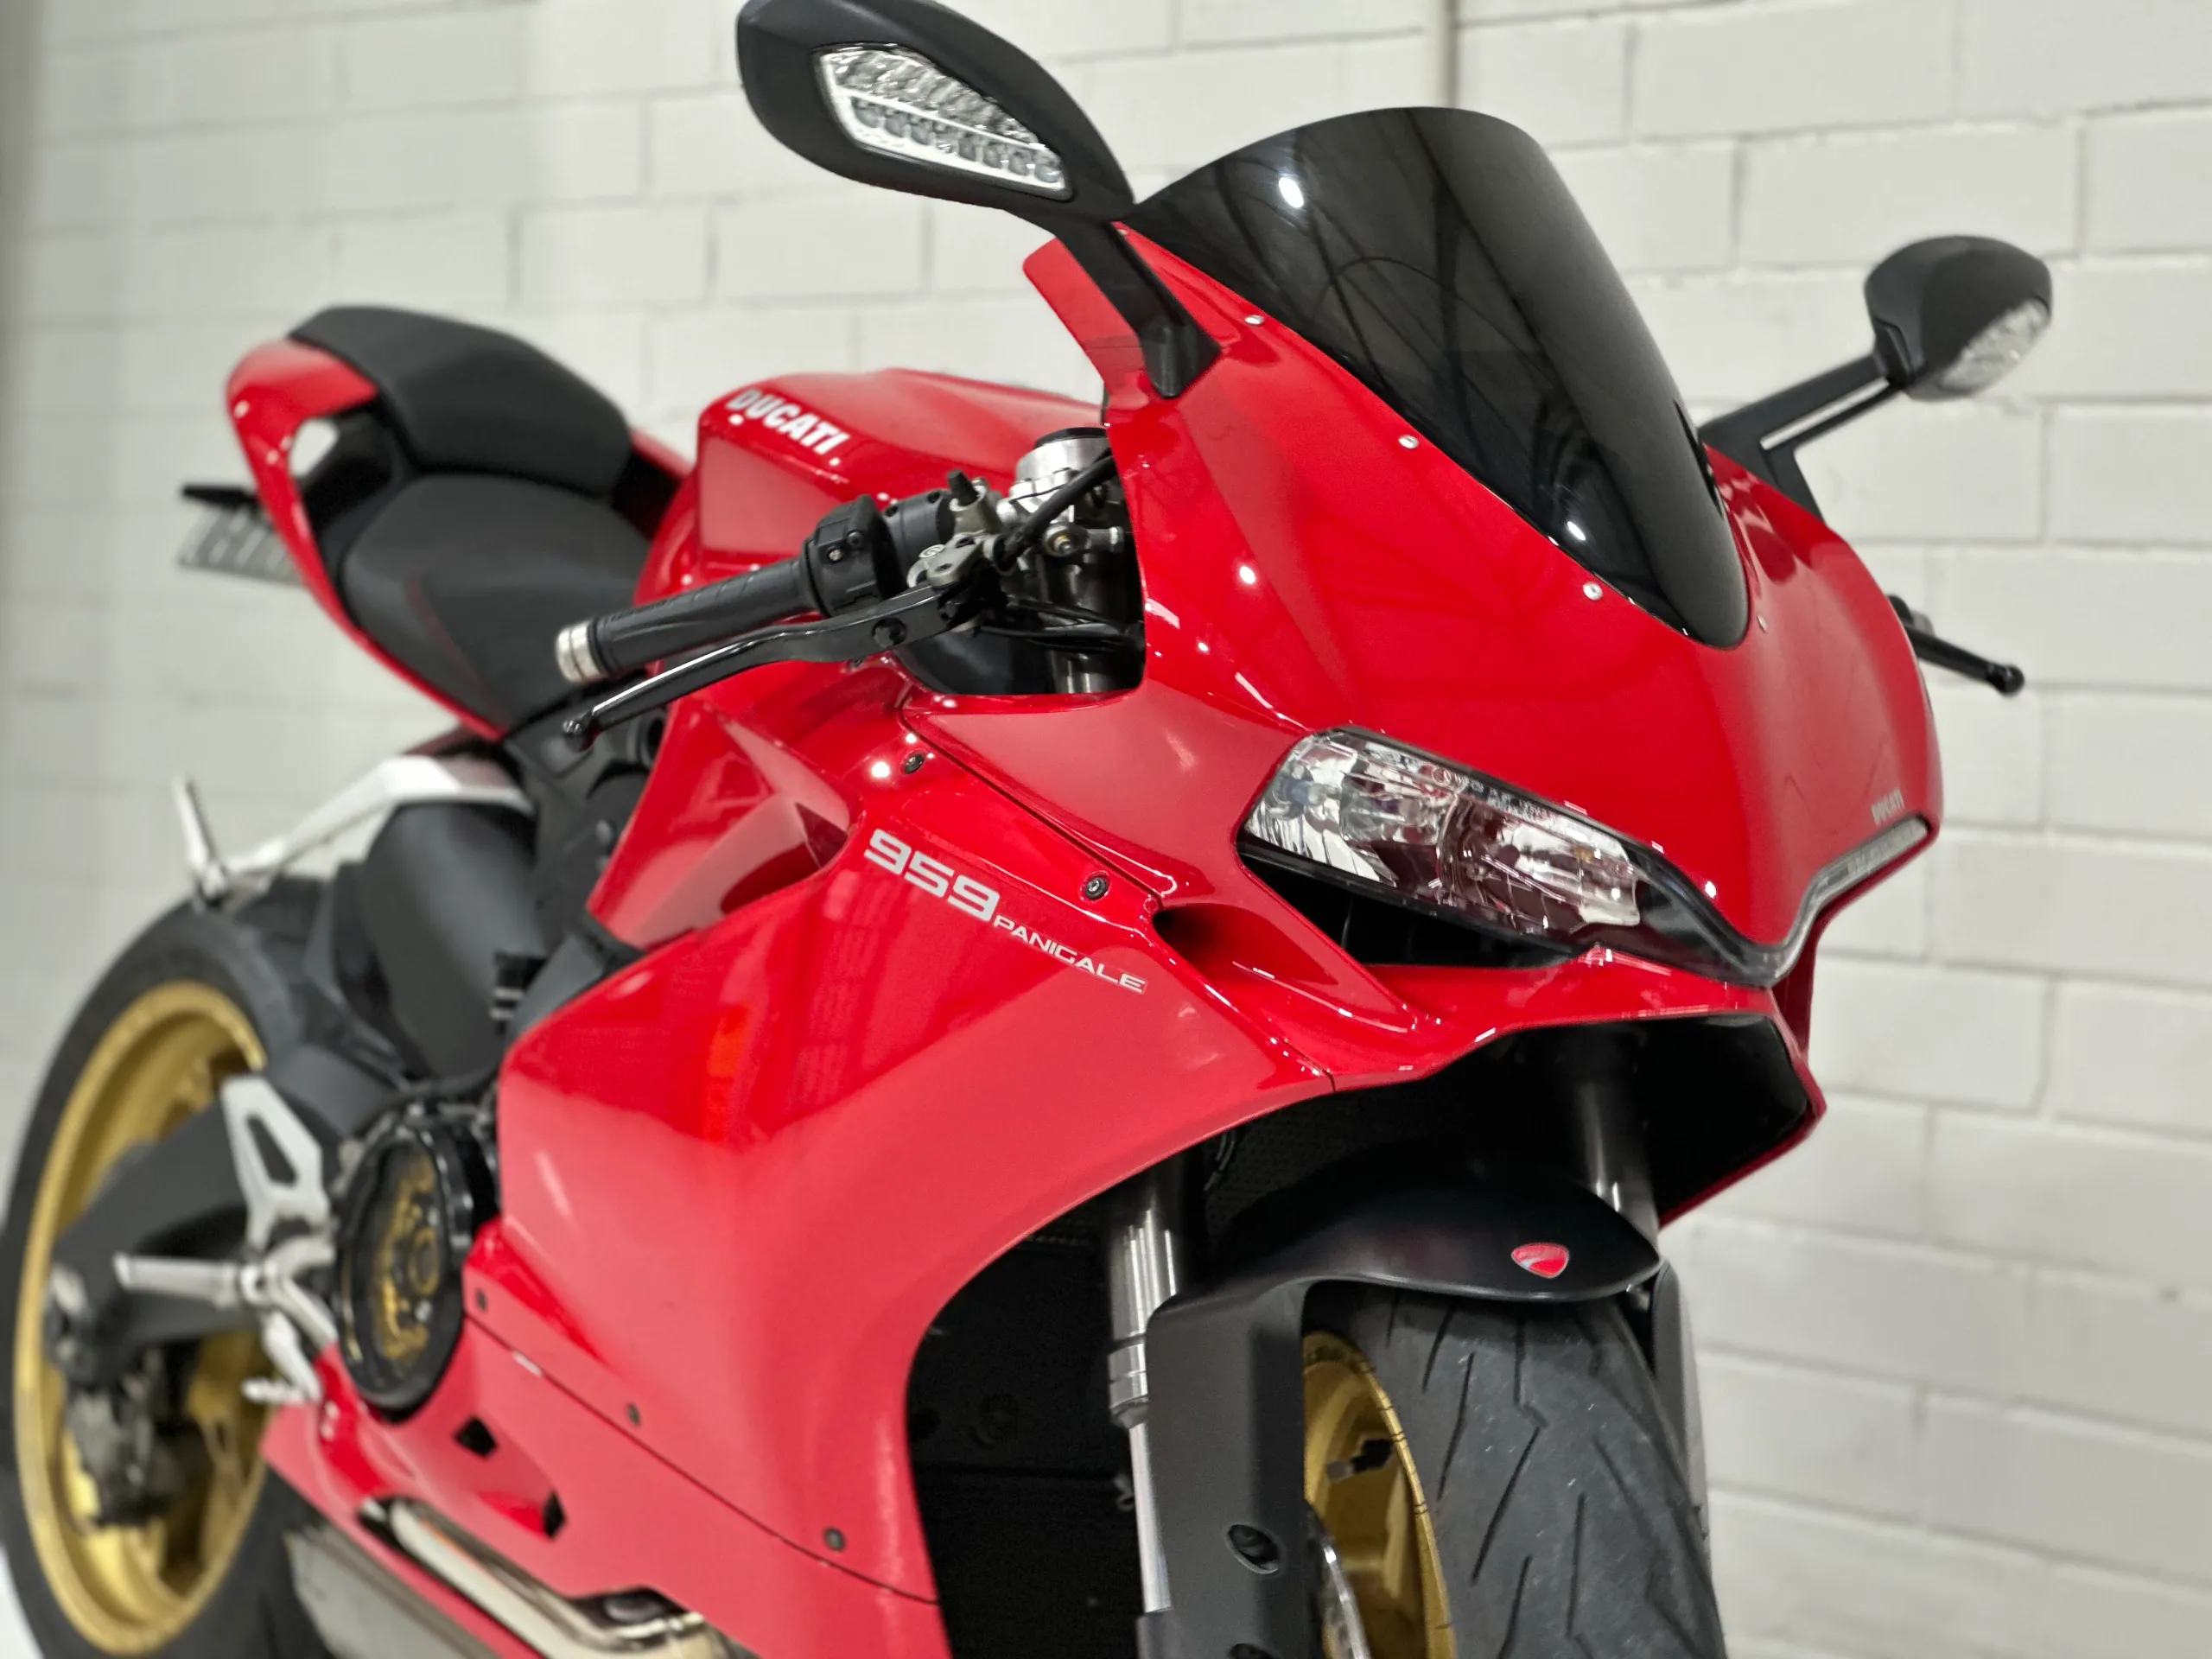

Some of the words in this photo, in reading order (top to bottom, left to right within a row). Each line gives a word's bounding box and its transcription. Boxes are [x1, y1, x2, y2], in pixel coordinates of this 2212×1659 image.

[724, 389, 850, 455] DUCATI
[864, 829, 1000, 922] 959
[994, 914, 1146, 994] PANIGALE
